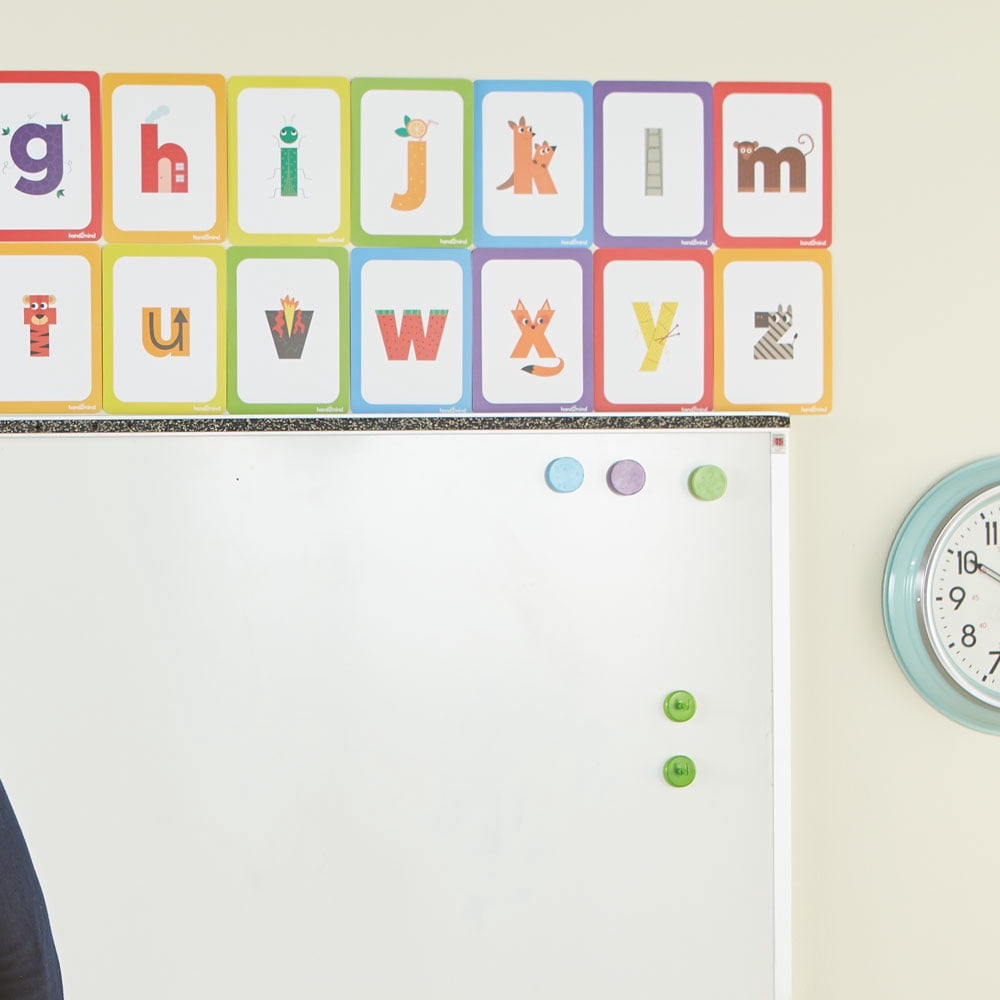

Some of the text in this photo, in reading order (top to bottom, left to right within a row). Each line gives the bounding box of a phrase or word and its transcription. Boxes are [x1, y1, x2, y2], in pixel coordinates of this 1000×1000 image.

[9, 122, 64, 196] g
[140, 123, 189, 194] h
[510, 118, 559, 195] k
[734, 142, 808, 193] m
[22, 294, 57, 357] t
[141, 306, 191, 358] u
[264, 304, 315, 360] v
[374, 309, 449, 361] w
[509, 306, 558, 359] x
[631, 301, 680, 373] y
[753, 308, 796, 361] z
[957, 550, 978, 575] 10
[949, 586, 966, 611] 9
[961, 624, 977, 648] 8
[989, 650, 1000, 675] 7
